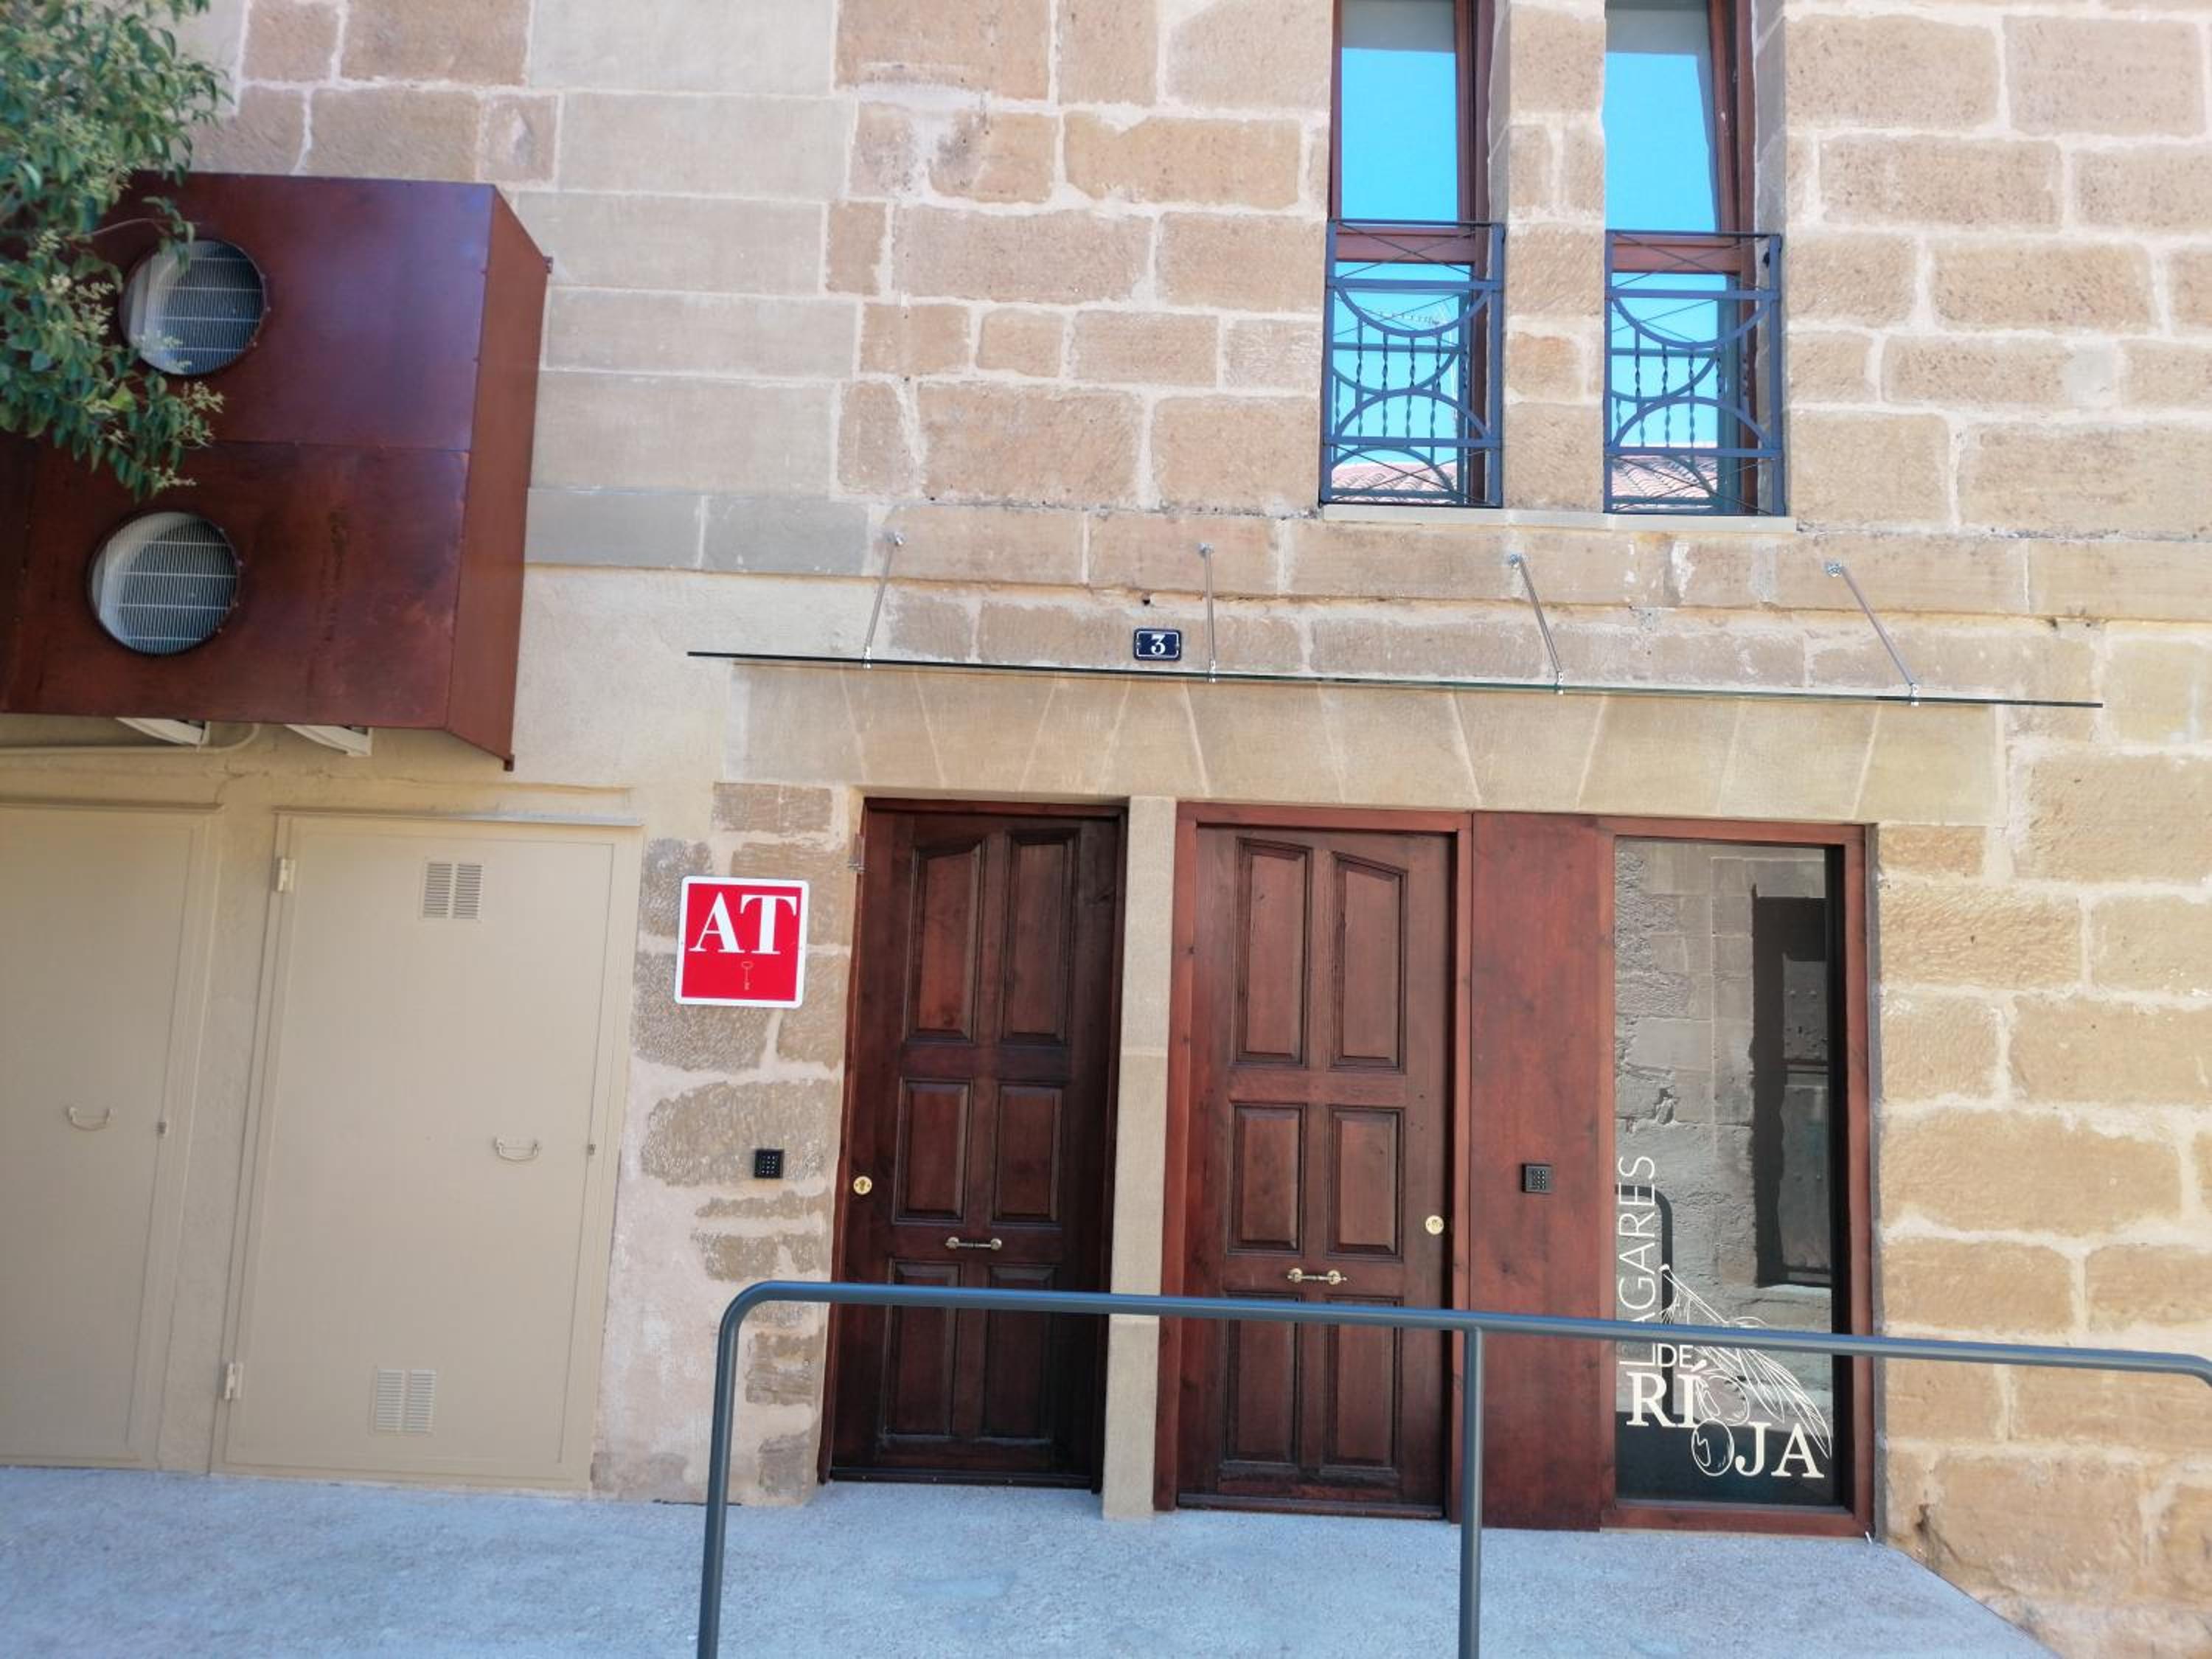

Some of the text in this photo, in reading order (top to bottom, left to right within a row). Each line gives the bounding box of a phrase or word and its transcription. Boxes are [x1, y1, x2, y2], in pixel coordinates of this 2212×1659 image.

[1150, 633, 1166, 655] 3
[688, 891, 798, 956] AT
[1618, 1155, 1656, 1366] LGARES
[1657, 1343, 1694, 1368] DE
[1625, 1371, 1825, 1478] RIOJA
